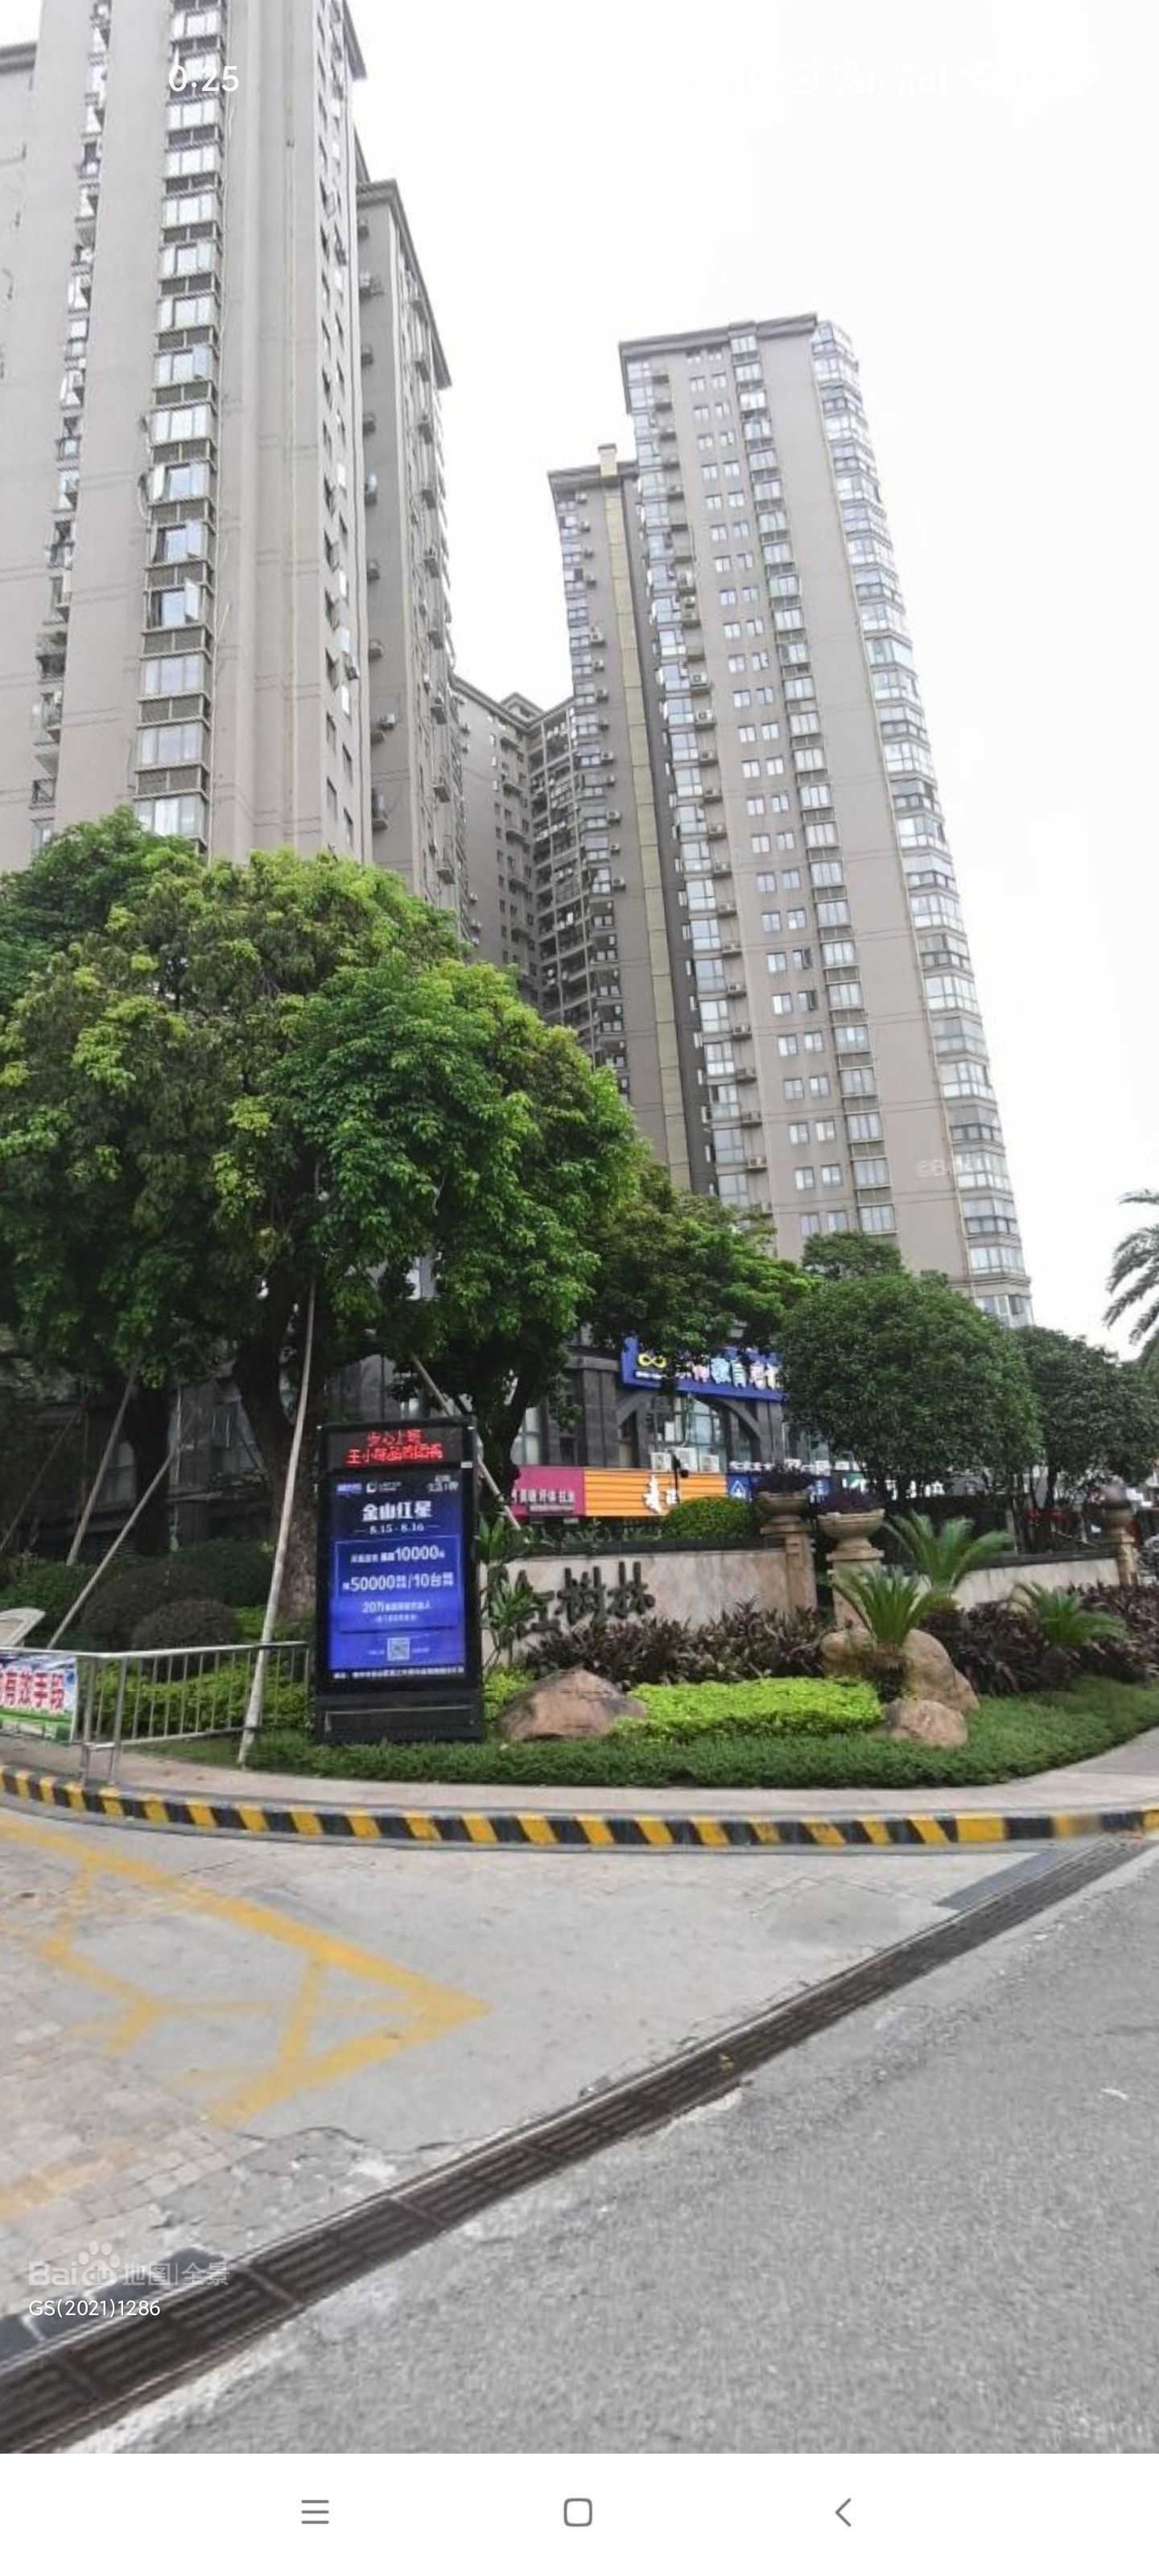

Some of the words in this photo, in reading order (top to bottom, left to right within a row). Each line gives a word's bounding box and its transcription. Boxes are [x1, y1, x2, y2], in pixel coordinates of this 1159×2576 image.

[362, 1501, 433, 1522] 金山红星
[0, 1668, 64, 1711] 有效手段
